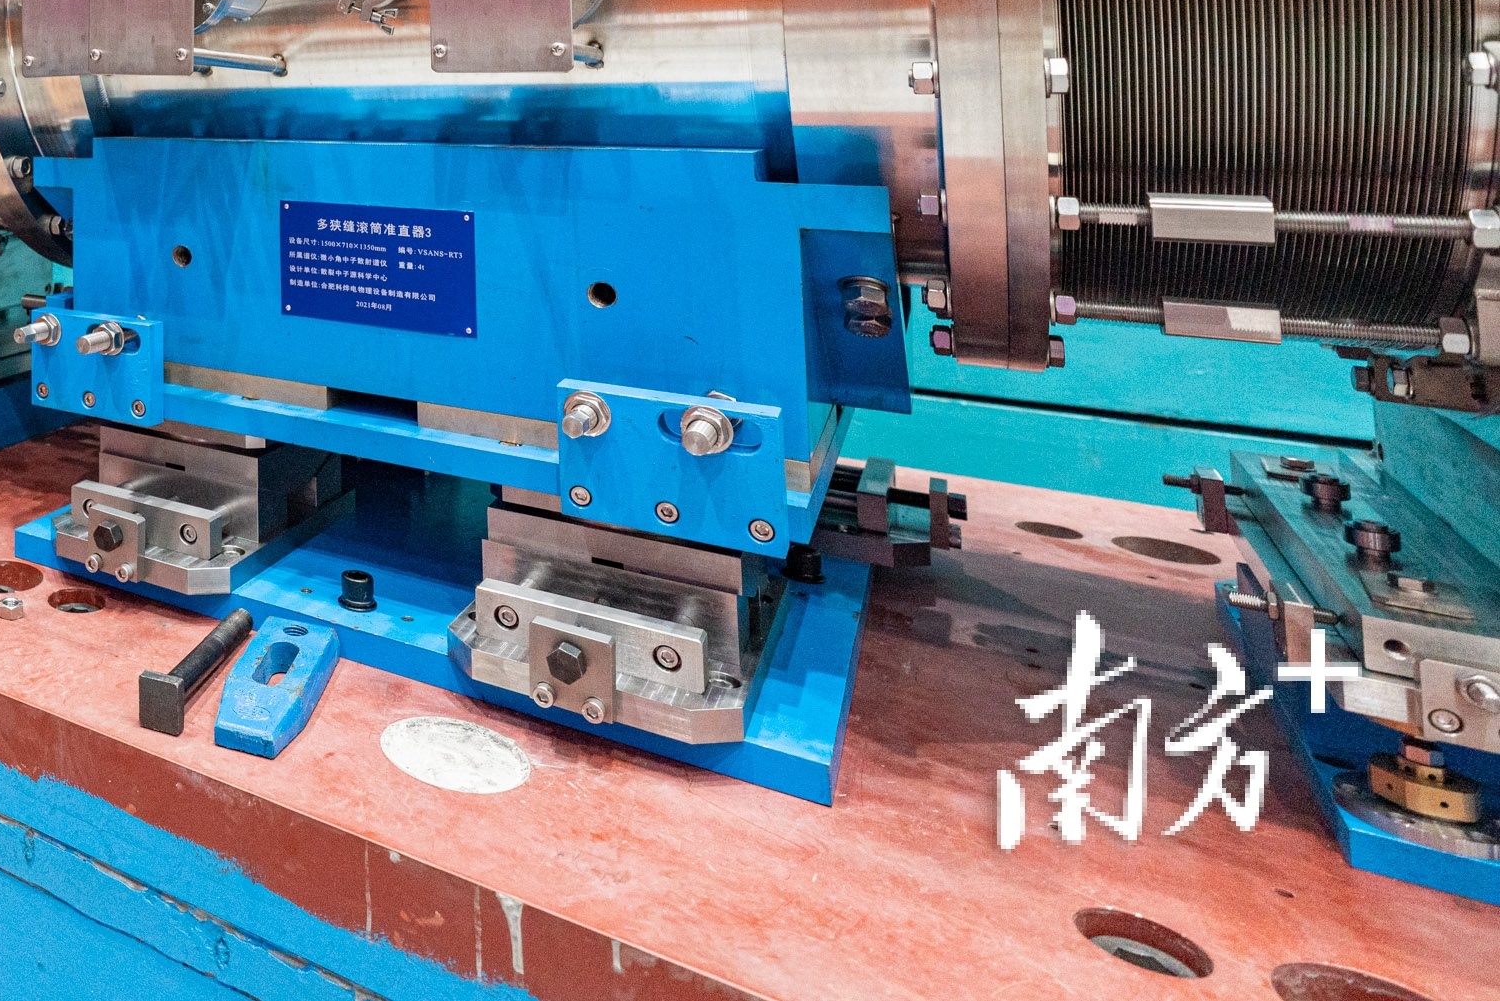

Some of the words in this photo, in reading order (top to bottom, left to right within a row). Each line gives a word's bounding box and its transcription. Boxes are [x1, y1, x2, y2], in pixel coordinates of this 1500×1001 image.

[317, 218, 432, 239] 多狭缝滚筒准直器3
[356, 301, 392, 312] 2021年08月
